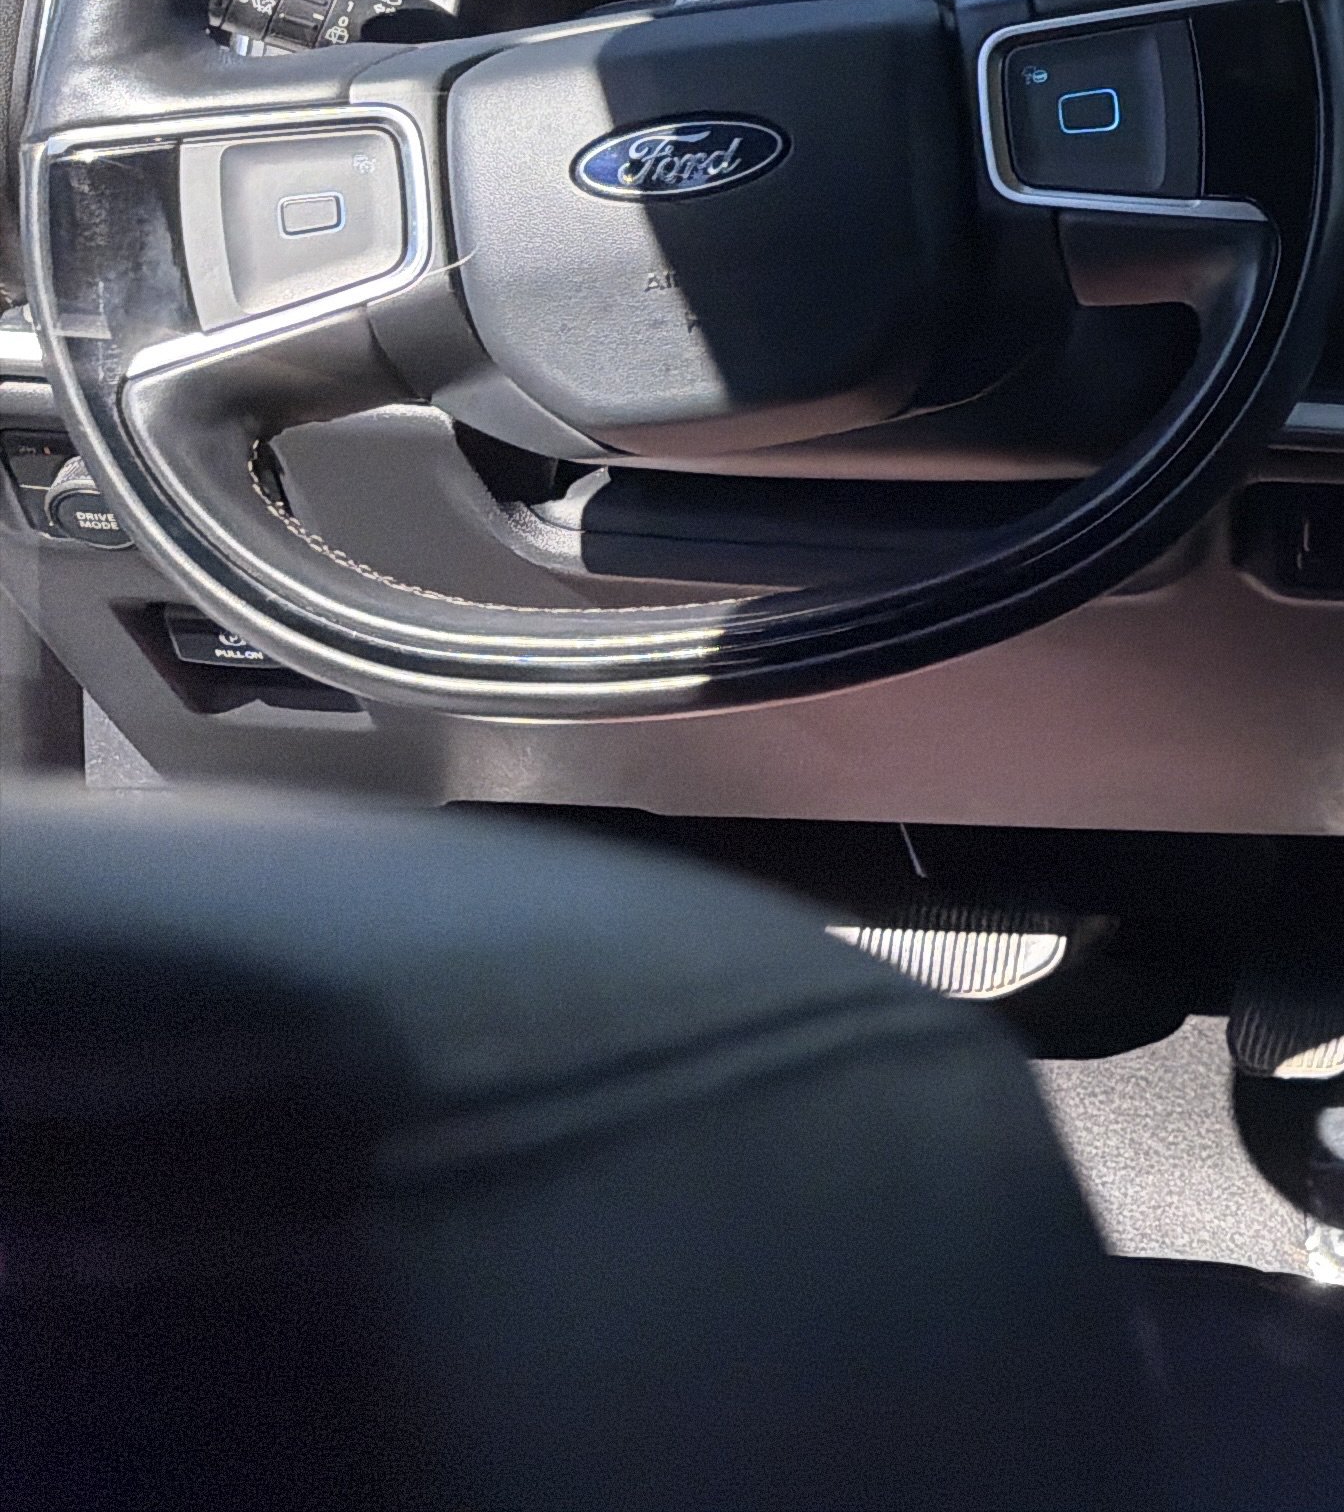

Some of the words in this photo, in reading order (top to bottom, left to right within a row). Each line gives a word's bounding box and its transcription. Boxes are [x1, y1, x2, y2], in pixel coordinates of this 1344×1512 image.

[617, 130, 743, 185] Ford
[76, 511, 116, 522] DRIVE
[79, 520, 119, 530] MODE
[215, 649, 242, 659] PULL
[244, 650, 264, 660] ON
